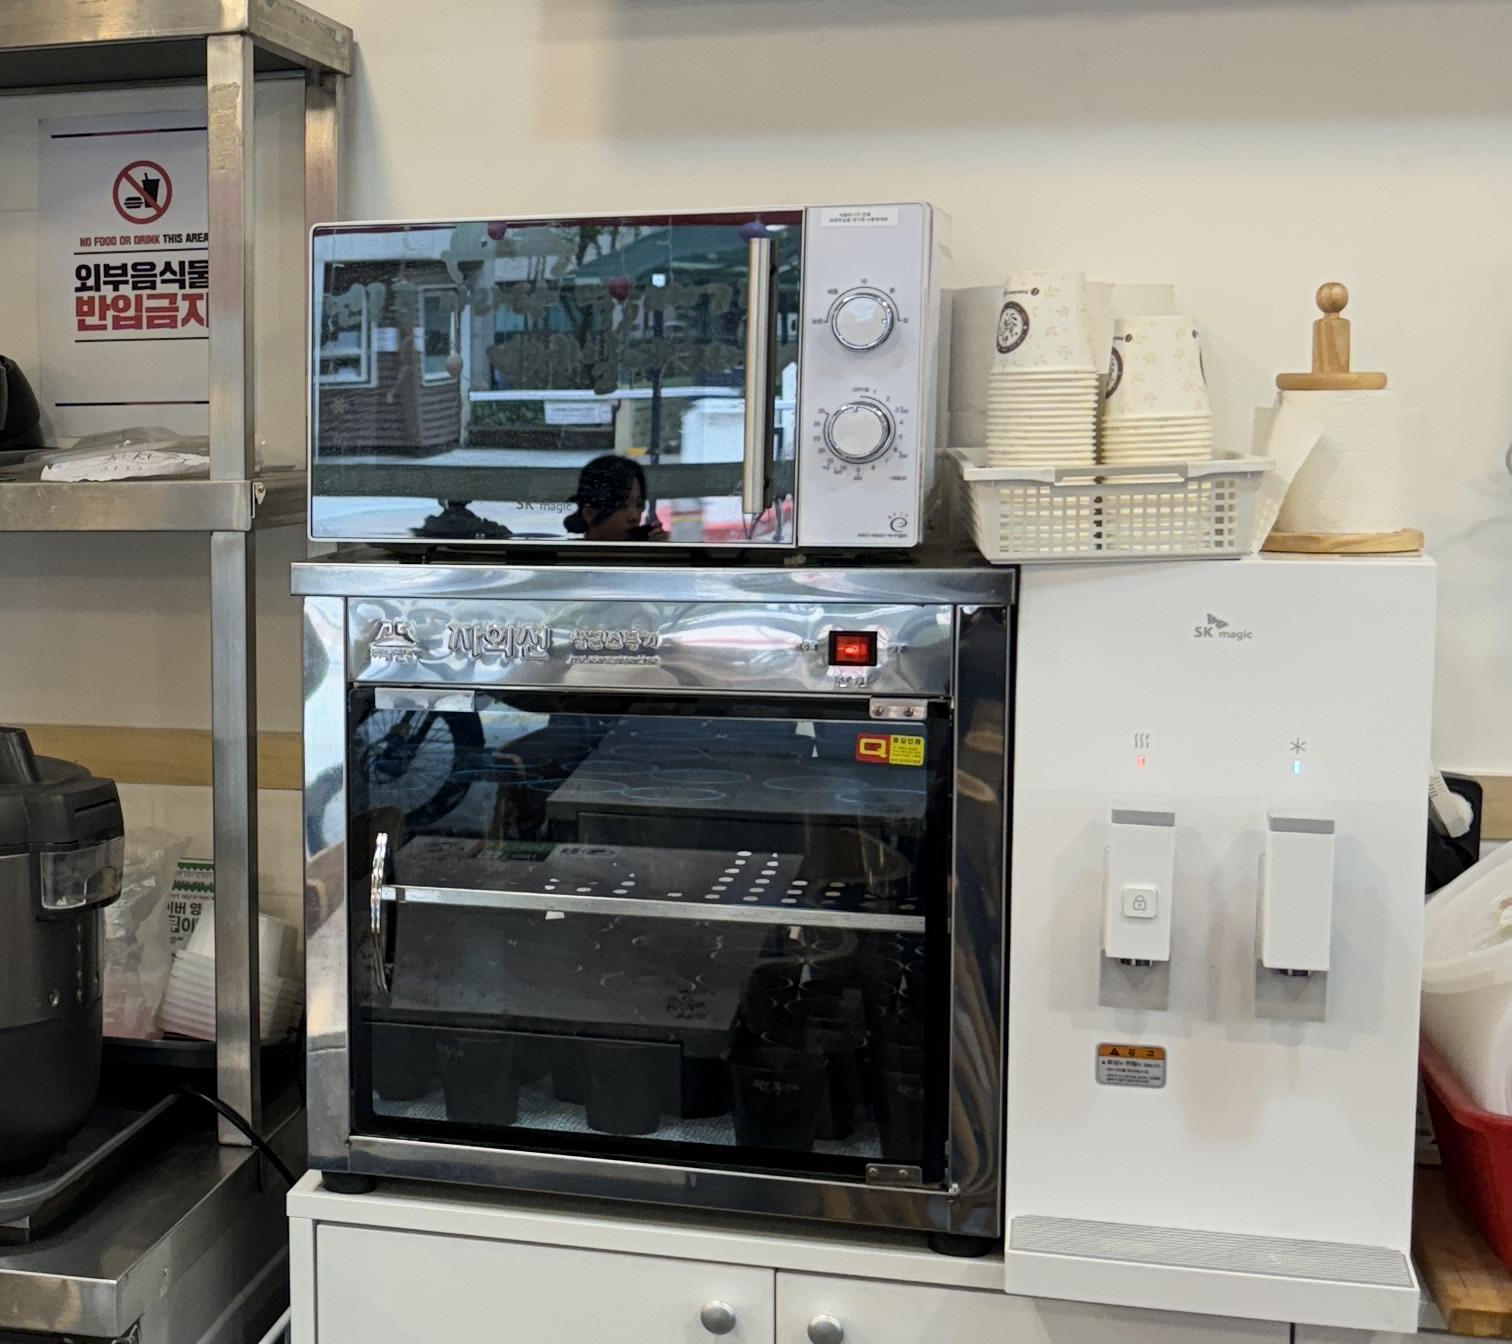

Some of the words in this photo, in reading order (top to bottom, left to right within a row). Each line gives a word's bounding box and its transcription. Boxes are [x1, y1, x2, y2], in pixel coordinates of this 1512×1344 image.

[80, 237, 92, 247] NO
[94, 235, 118, 247] FOOD
[119, 234, 132, 246] OR
[133, 233, 161, 246] DRINK
[163, 233, 184, 245] THIS
[74, 260, 209, 293] 외부음식물
[75, 292, 209, 332] 반입금지
[539, 501, 573, 513] magic
[447, 622, 553, 660] 자외선
[1193, 625, 1214, 638] SK
[1219, 630, 1253, 641] magic
